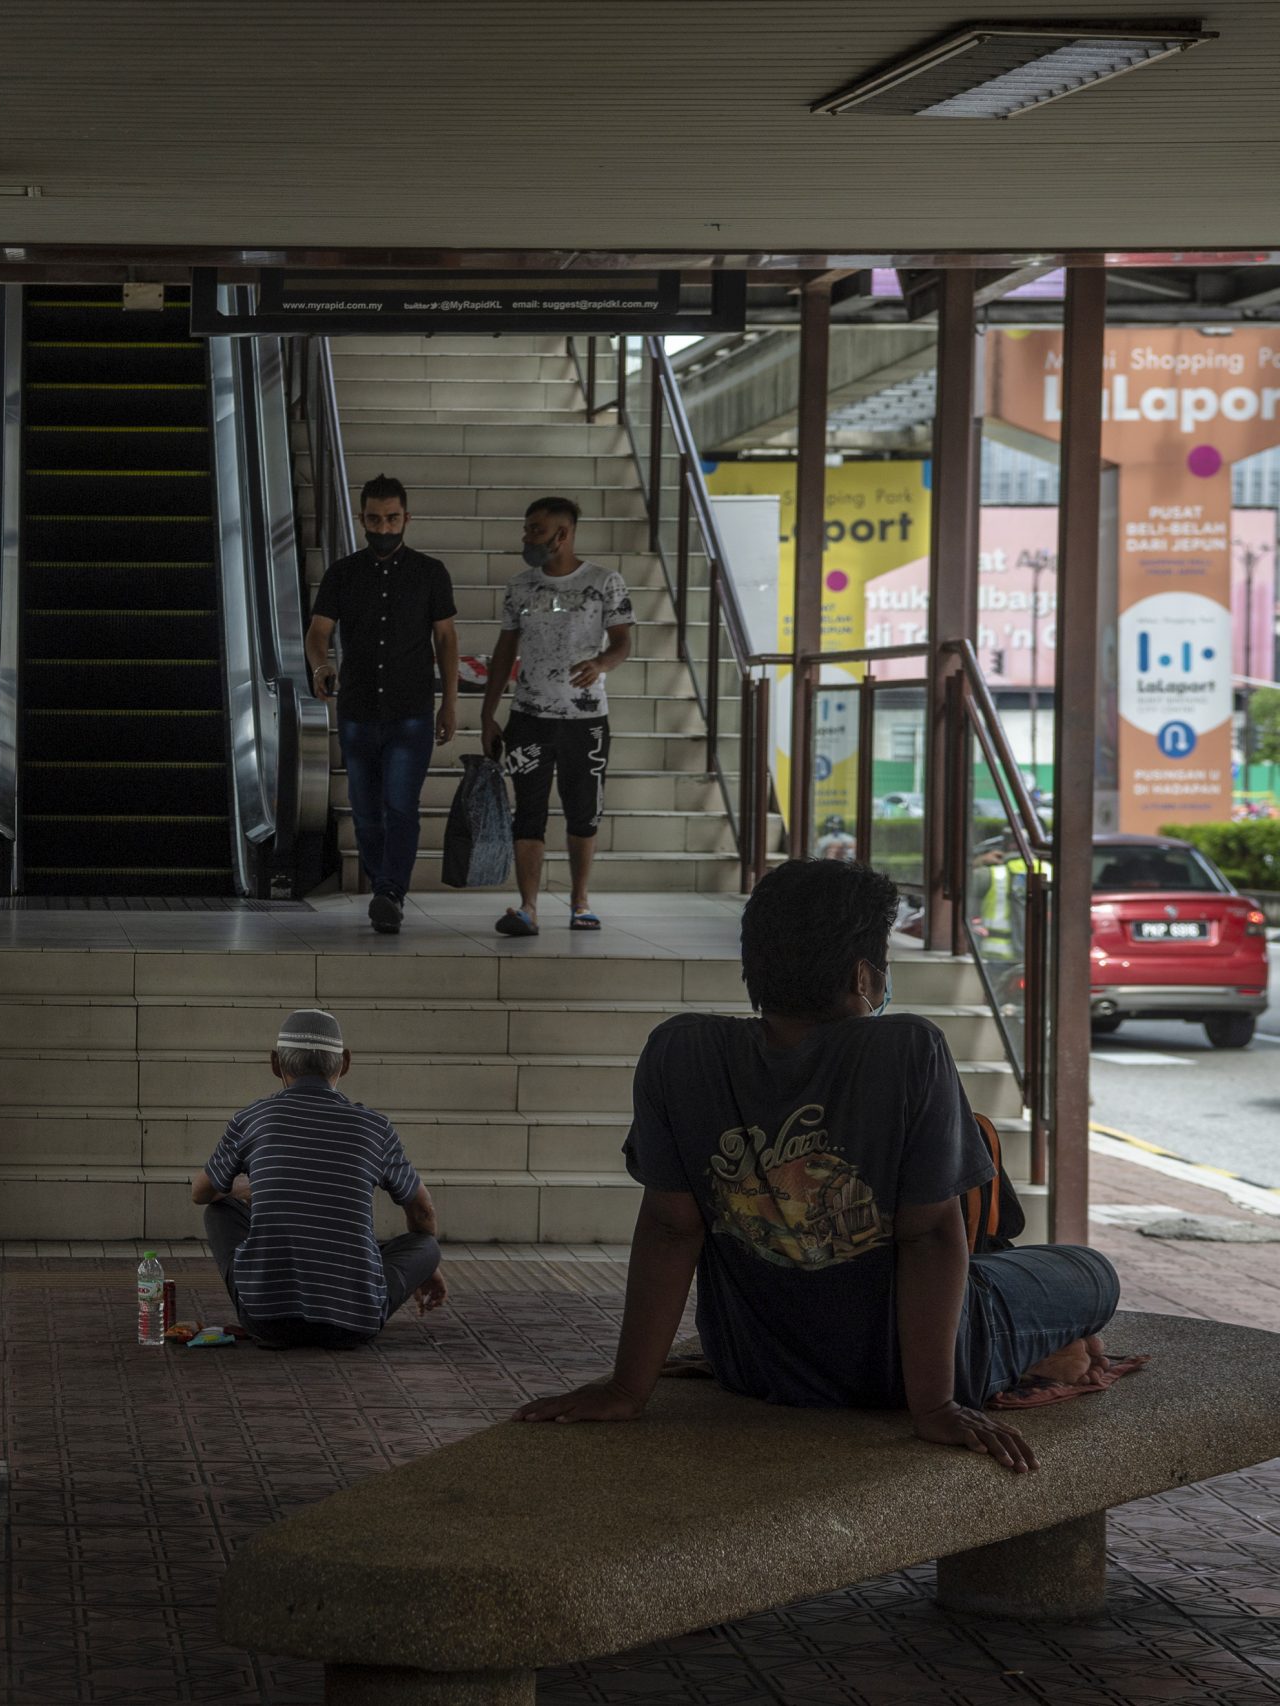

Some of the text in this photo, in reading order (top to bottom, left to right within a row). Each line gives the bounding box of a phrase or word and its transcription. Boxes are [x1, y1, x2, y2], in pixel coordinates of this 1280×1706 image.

[282, 301, 383, 311] www.myrapid.com.my
[512, 300, 540, 309] email:
[542, 300, 659, 310] suggest@rapidkl.com.my
[1130, 347, 1245, 375] Shopping
[1043, 374, 1280, 433] LLapor
[875, 487, 912, 504] Park
[1148, 505, 1204, 520] PUSAT
[1125, 522, 1227, 536] BELI-BELAH
[1137, 680, 1216, 695] LaLaport
